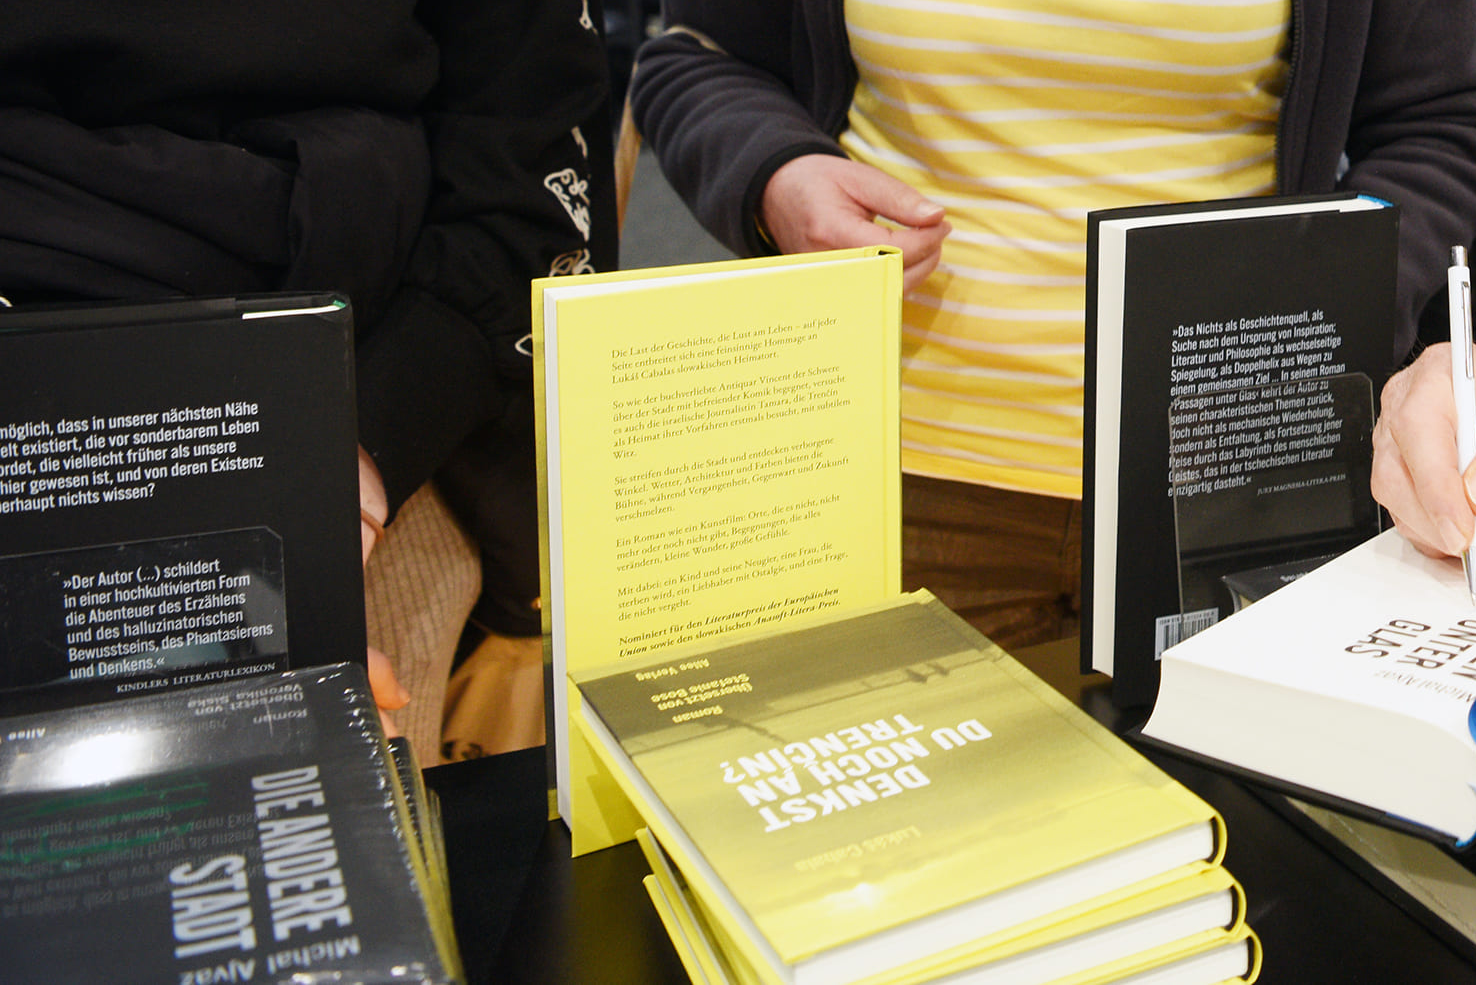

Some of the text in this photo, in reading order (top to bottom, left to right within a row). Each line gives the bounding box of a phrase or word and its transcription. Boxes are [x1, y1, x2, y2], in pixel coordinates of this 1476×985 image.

[612, 350, 626, 358] Die
[630, 347, 647, 355] Last
[650, 343, 664, 352] der
[666, 336, 715, 349] Geschichte,
[717, 333, 729, 342] die
[732, 331, 750, 339] Lust
[768, 324, 792, 334] Leben
[803, 319, 816, 328] auf
[818, 317, 836, 329] jeder
[1196, 322, 1222, 334] Nichts
[1225, 319, 1237, 331] als
[1312, 309, 1323, 321] als
[612, 362, 632, 370] Seite
[634, 355, 675, 367] entbreitet
[679, 350, 694, 360] sich
[697, 349, 714, 357] eine
[716, 341, 762, 354] feinsinnige
[764, 336, 804, 347] Hommage
[1171, 335, 1341, 367] Literatur und Philosophie als wechselseitige
[1172, 339, 1197, 352] Suche
[1199, 336, 1218, 348] nach
[1221, 334, 1238, 346] dem
[1240, 331, 1276, 344] Ursprung
[1278, 329, 1291, 339] von
[677, 358, 731, 372] slowakischen
[1170, 384, 1195, 396] einem
[1197, 376, 1253, 394] gemeinsamen
[1255, 372, 1269, 385] Ziel
[1281, 370, 1288, 383] In
[1290, 367, 1317, 380] seinem
[1319, 363, 1345, 375] Roman
[1220, 363, 1232, 375] als
[1234, 357, 1279, 374] Doppelhelix
[1281, 356, 1294, 367] aus
[1296, 353, 1321, 365] Wegen
[1323, 352, 1332, 361] zu
[57, 419, 88, 433] dass
[92, 416, 104, 430] in
[108, 413, 158, 428] unserer
[162, 406, 221, 423] nächsten
[225, 401, 257, 416] Nähe
[1199, 402, 1273, 421] charakteristischen
[1275, 397, 1305, 410] Themen
[22, 437, 81, 455] existiert,
[85, 435, 105, 449] die
[108, 434, 129, 446] vor
[133, 425, 217, 444] sonderbarem
[221, 420, 258, 435] Leben
[39, 457, 59, 472] die
[62, 451, 123, 469] vielleicht
[126, 447, 167, 463] früher
[170, 444, 189, 458] als
[193, 441, 236, 456] unsere
[0, 456, 263, 494] hier gewesen ist, und von deren Existenz
[58, 490, 99, 506] nichts
[102, 483, 154, 501] wissen?
[64, 575, 94, 589] »Der
[98, 571, 133, 586] Autor
[164, 559, 220, 578] schildert
[64, 574, 250, 608] in einer hochkultivierten Form
[65, 593, 245, 626] die Abenteuer des Erzählens
[620, 629, 666, 645] Nominiert
[670, 625, 683, 633] für
[705, 605, 765, 624] Literaturpreis
[767, 601, 781, 609] der
[67, 610, 242, 643] und des halluzinatorischen
[68, 624, 273, 661] Bewusstseins, des Phantasierens
[619, 646, 646, 656] Union
[650, 638, 673, 649] sowie
[676, 635, 692, 643] den
[695, 621, 750, 638] slowakischen
[1344, 619, 1432, 659] GLAS
[70, 656, 164, 679] und Denkens.«
[635, 658, 711, 682] Allee Verlag
[117, 678, 168, 692] KINDLERS
[235, 683, 303, 699] Veronika
[657, 682, 753, 711] Übersetzt von
[688, 673, 750, 695] Stefanie
[195, 704, 224, 716] von
[252, 708, 308, 725] Roman
[672, 704, 724, 724] Roman
[6, 727, 47, 741] Allee
[717, 711, 926, 785] TRENČÍN?
[736, 717, 993, 807] DU NOCH AN
[756, 762, 931, 833] DENKST
[251, 765, 353, 942] DIE ANDERE
[168, 854, 258, 959] STADT
[266, 934, 360, 976] Michal
